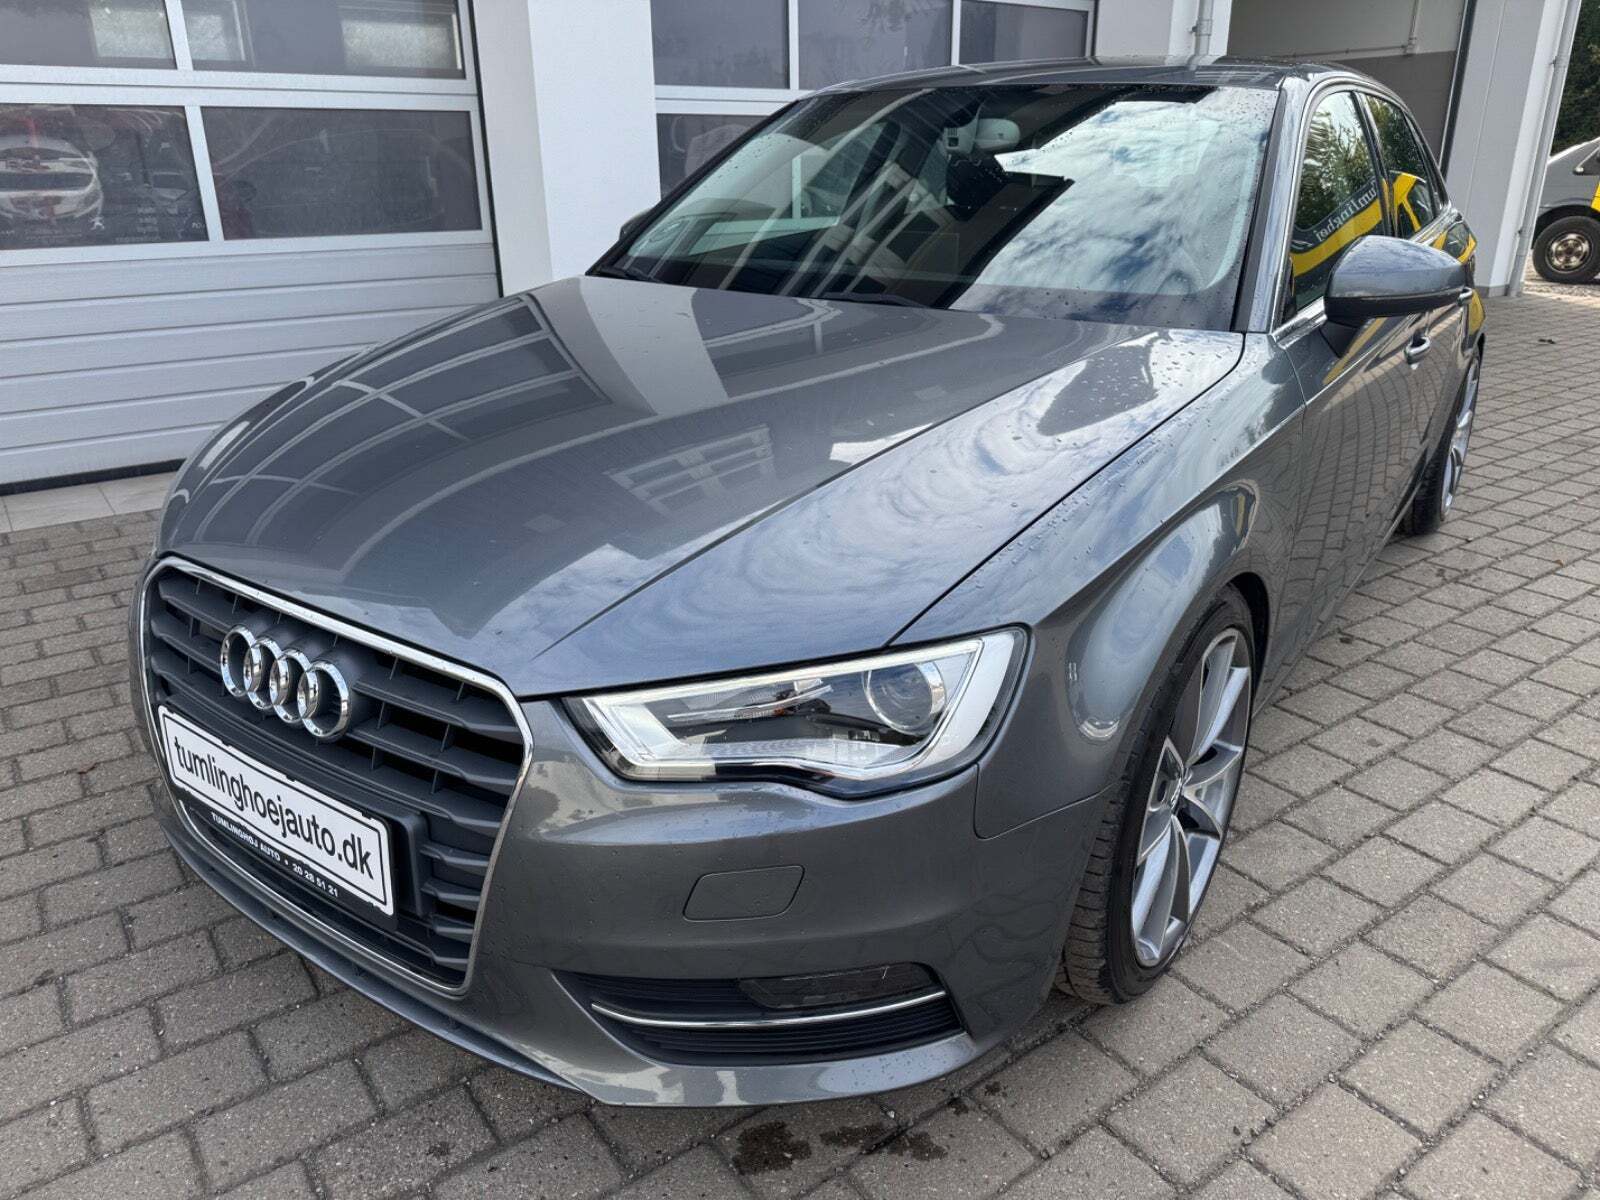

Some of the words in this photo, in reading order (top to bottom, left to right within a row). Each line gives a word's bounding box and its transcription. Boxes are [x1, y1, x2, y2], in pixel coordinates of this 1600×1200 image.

[174, 736, 374, 880] tumlinghoejauto.dk
[260, 842, 281, 861] AUTO
[292, 863, 303, 876] 20
[316, 877, 326, 891] 51
[327, 884, 338, 897] 21
